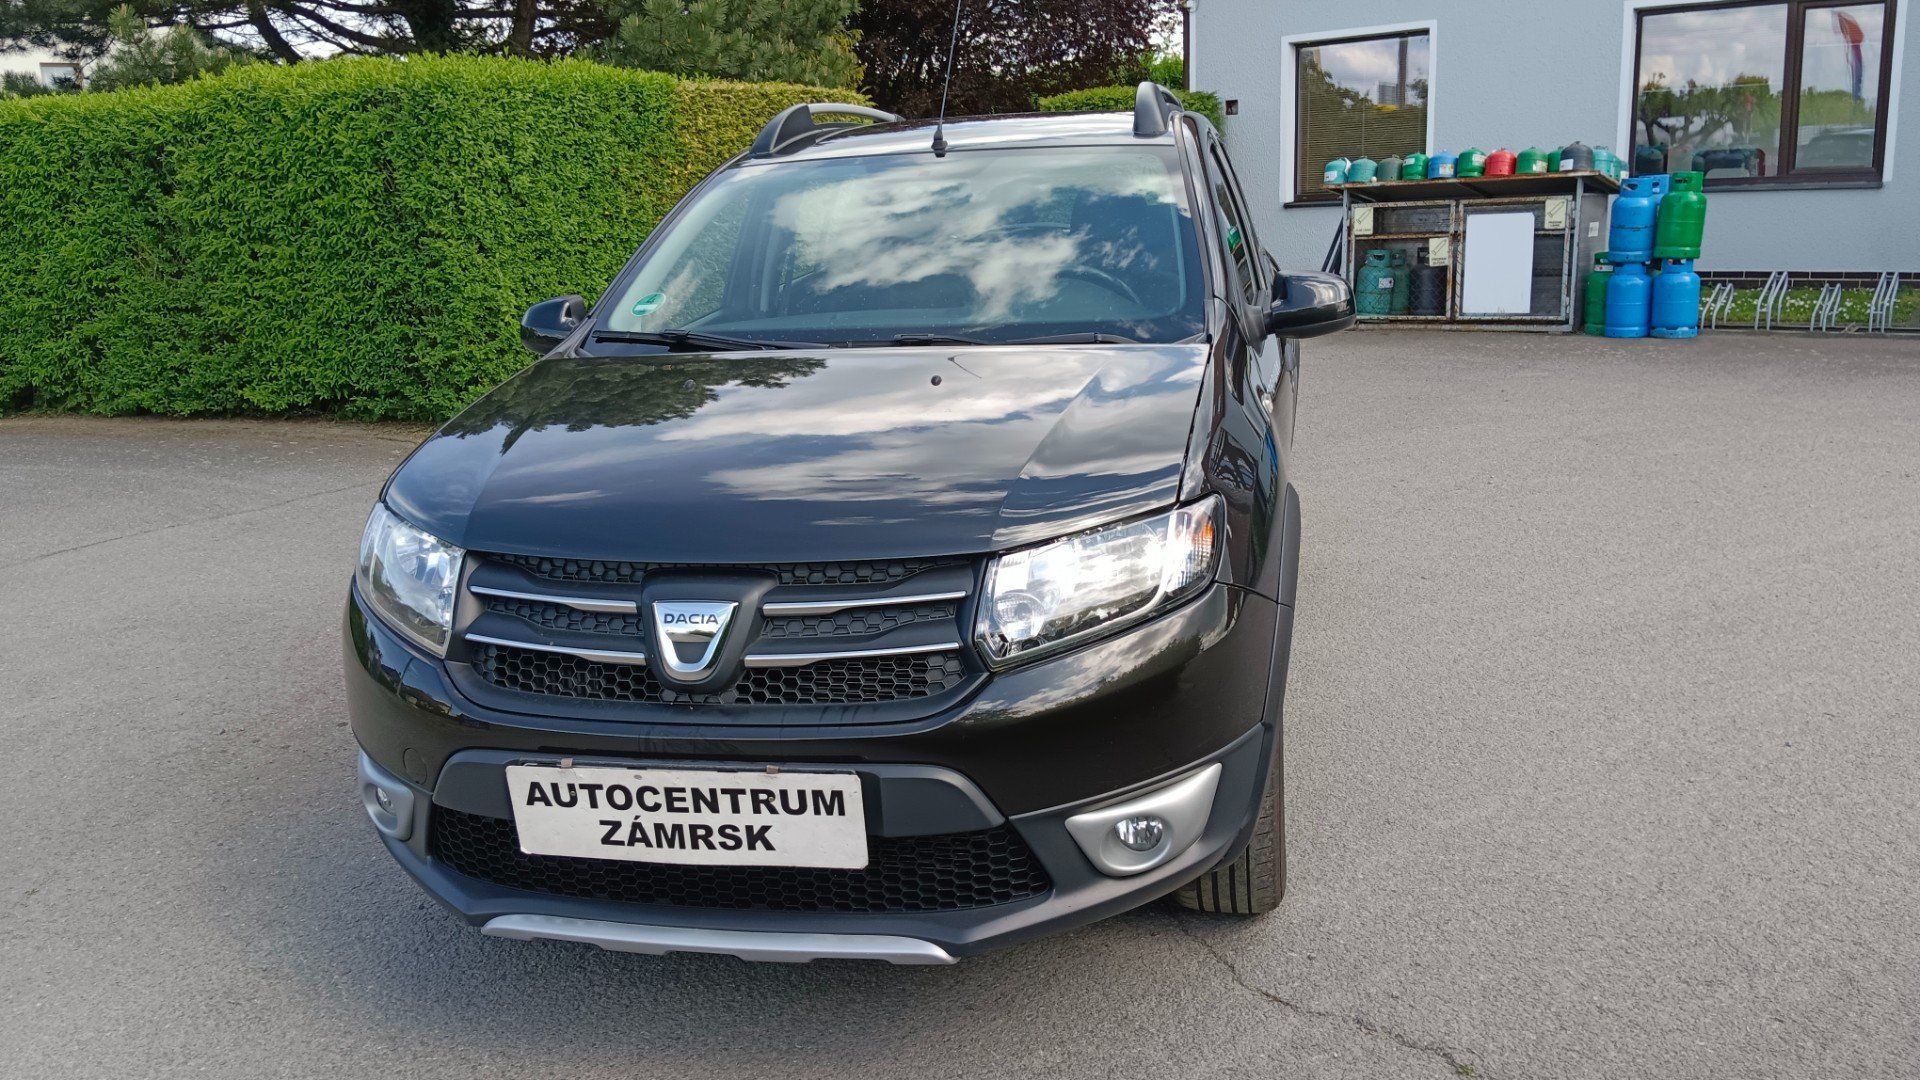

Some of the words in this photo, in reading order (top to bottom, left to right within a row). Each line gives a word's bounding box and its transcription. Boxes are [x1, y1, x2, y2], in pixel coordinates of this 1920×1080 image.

[664, 613, 718, 625] DACIA
[526, 781, 847, 816] AUTOCENTRUM
[599, 815, 776, 851] ZÁMRSK
